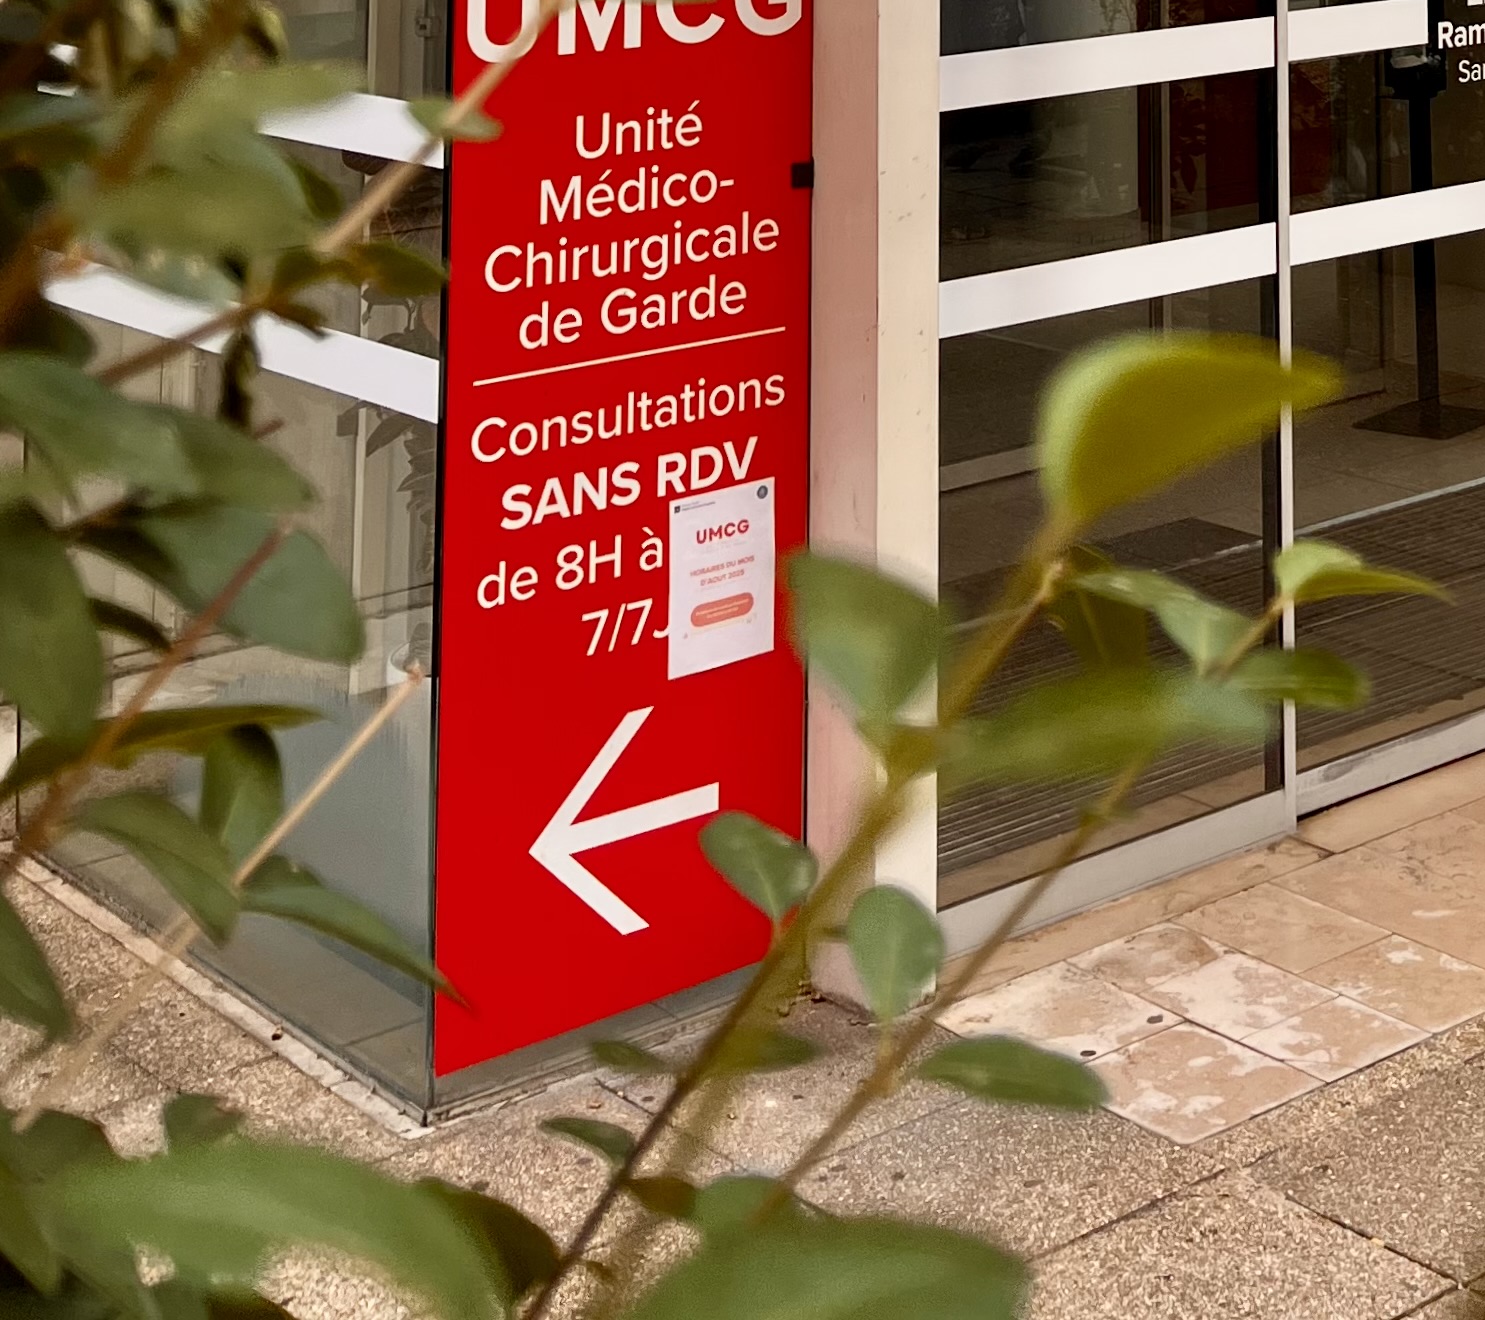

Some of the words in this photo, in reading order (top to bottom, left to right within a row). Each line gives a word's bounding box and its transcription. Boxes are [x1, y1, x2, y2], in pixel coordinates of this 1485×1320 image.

[576, 99, 703, 160] Unité
[539, 164, 735, 225] Médico-
[484, 211, 780, 294] Chirurgicale
[519, 300, 583, 351] de
[600, 274, 747, 335] Garde
[471, 373, 786, 463] Consultations
[500, 462, 641, 531] SANS
[657, 435, 759, 498] RDV
[477, 561, 538, 609] de
[555, 534, 622, 591] 8H
[638, 526, 664, 572] à
[696, 518, 750, 545] UMCG
